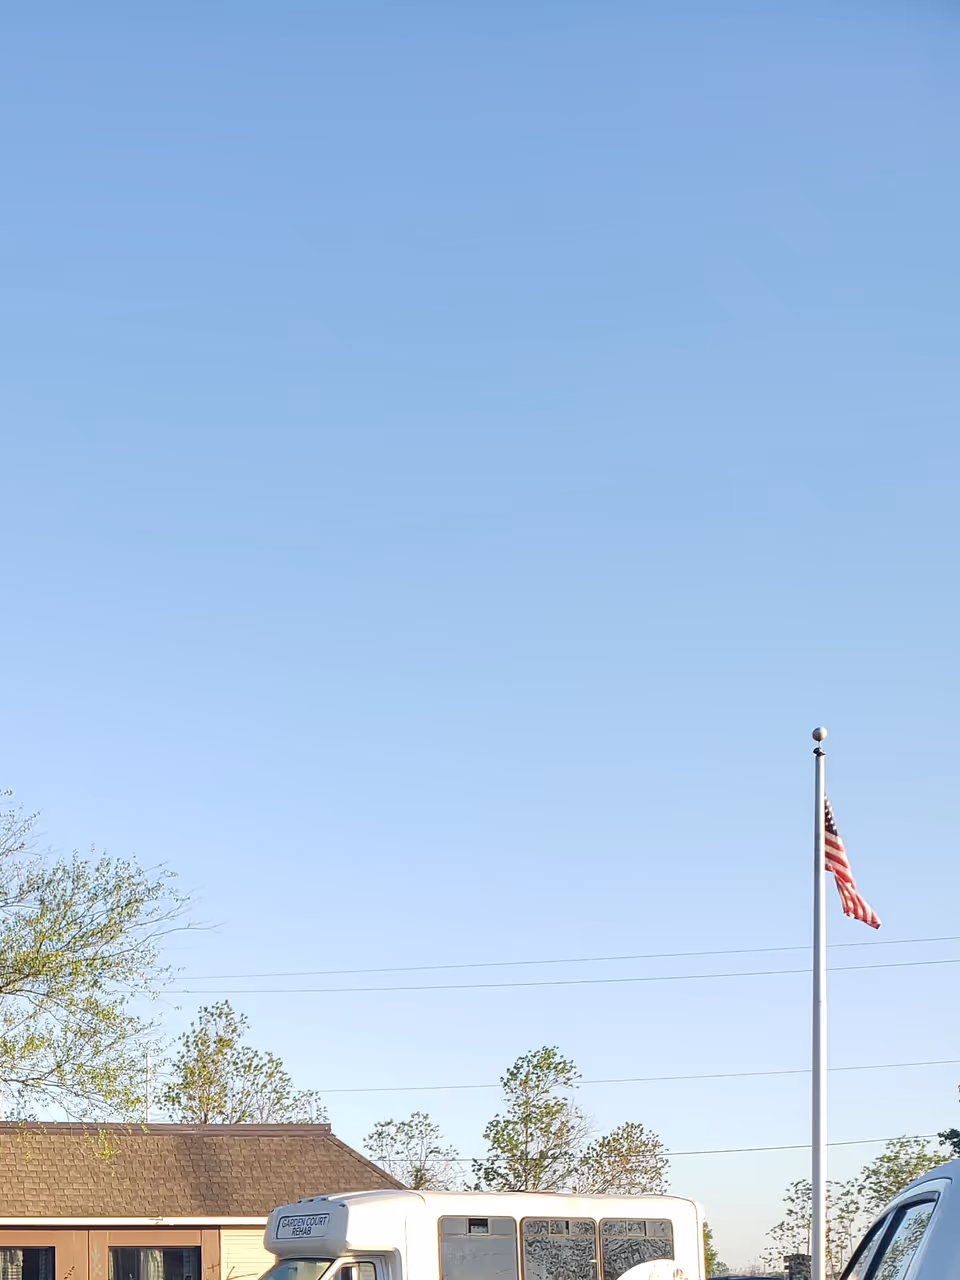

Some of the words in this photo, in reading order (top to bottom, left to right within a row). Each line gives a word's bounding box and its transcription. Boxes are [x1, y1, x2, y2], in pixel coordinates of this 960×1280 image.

[282, 1218, 305, 1228] GARDEN
[306, 1216, 327, 1226] COURT
[291, 1226, 312, 1236] REHAB
